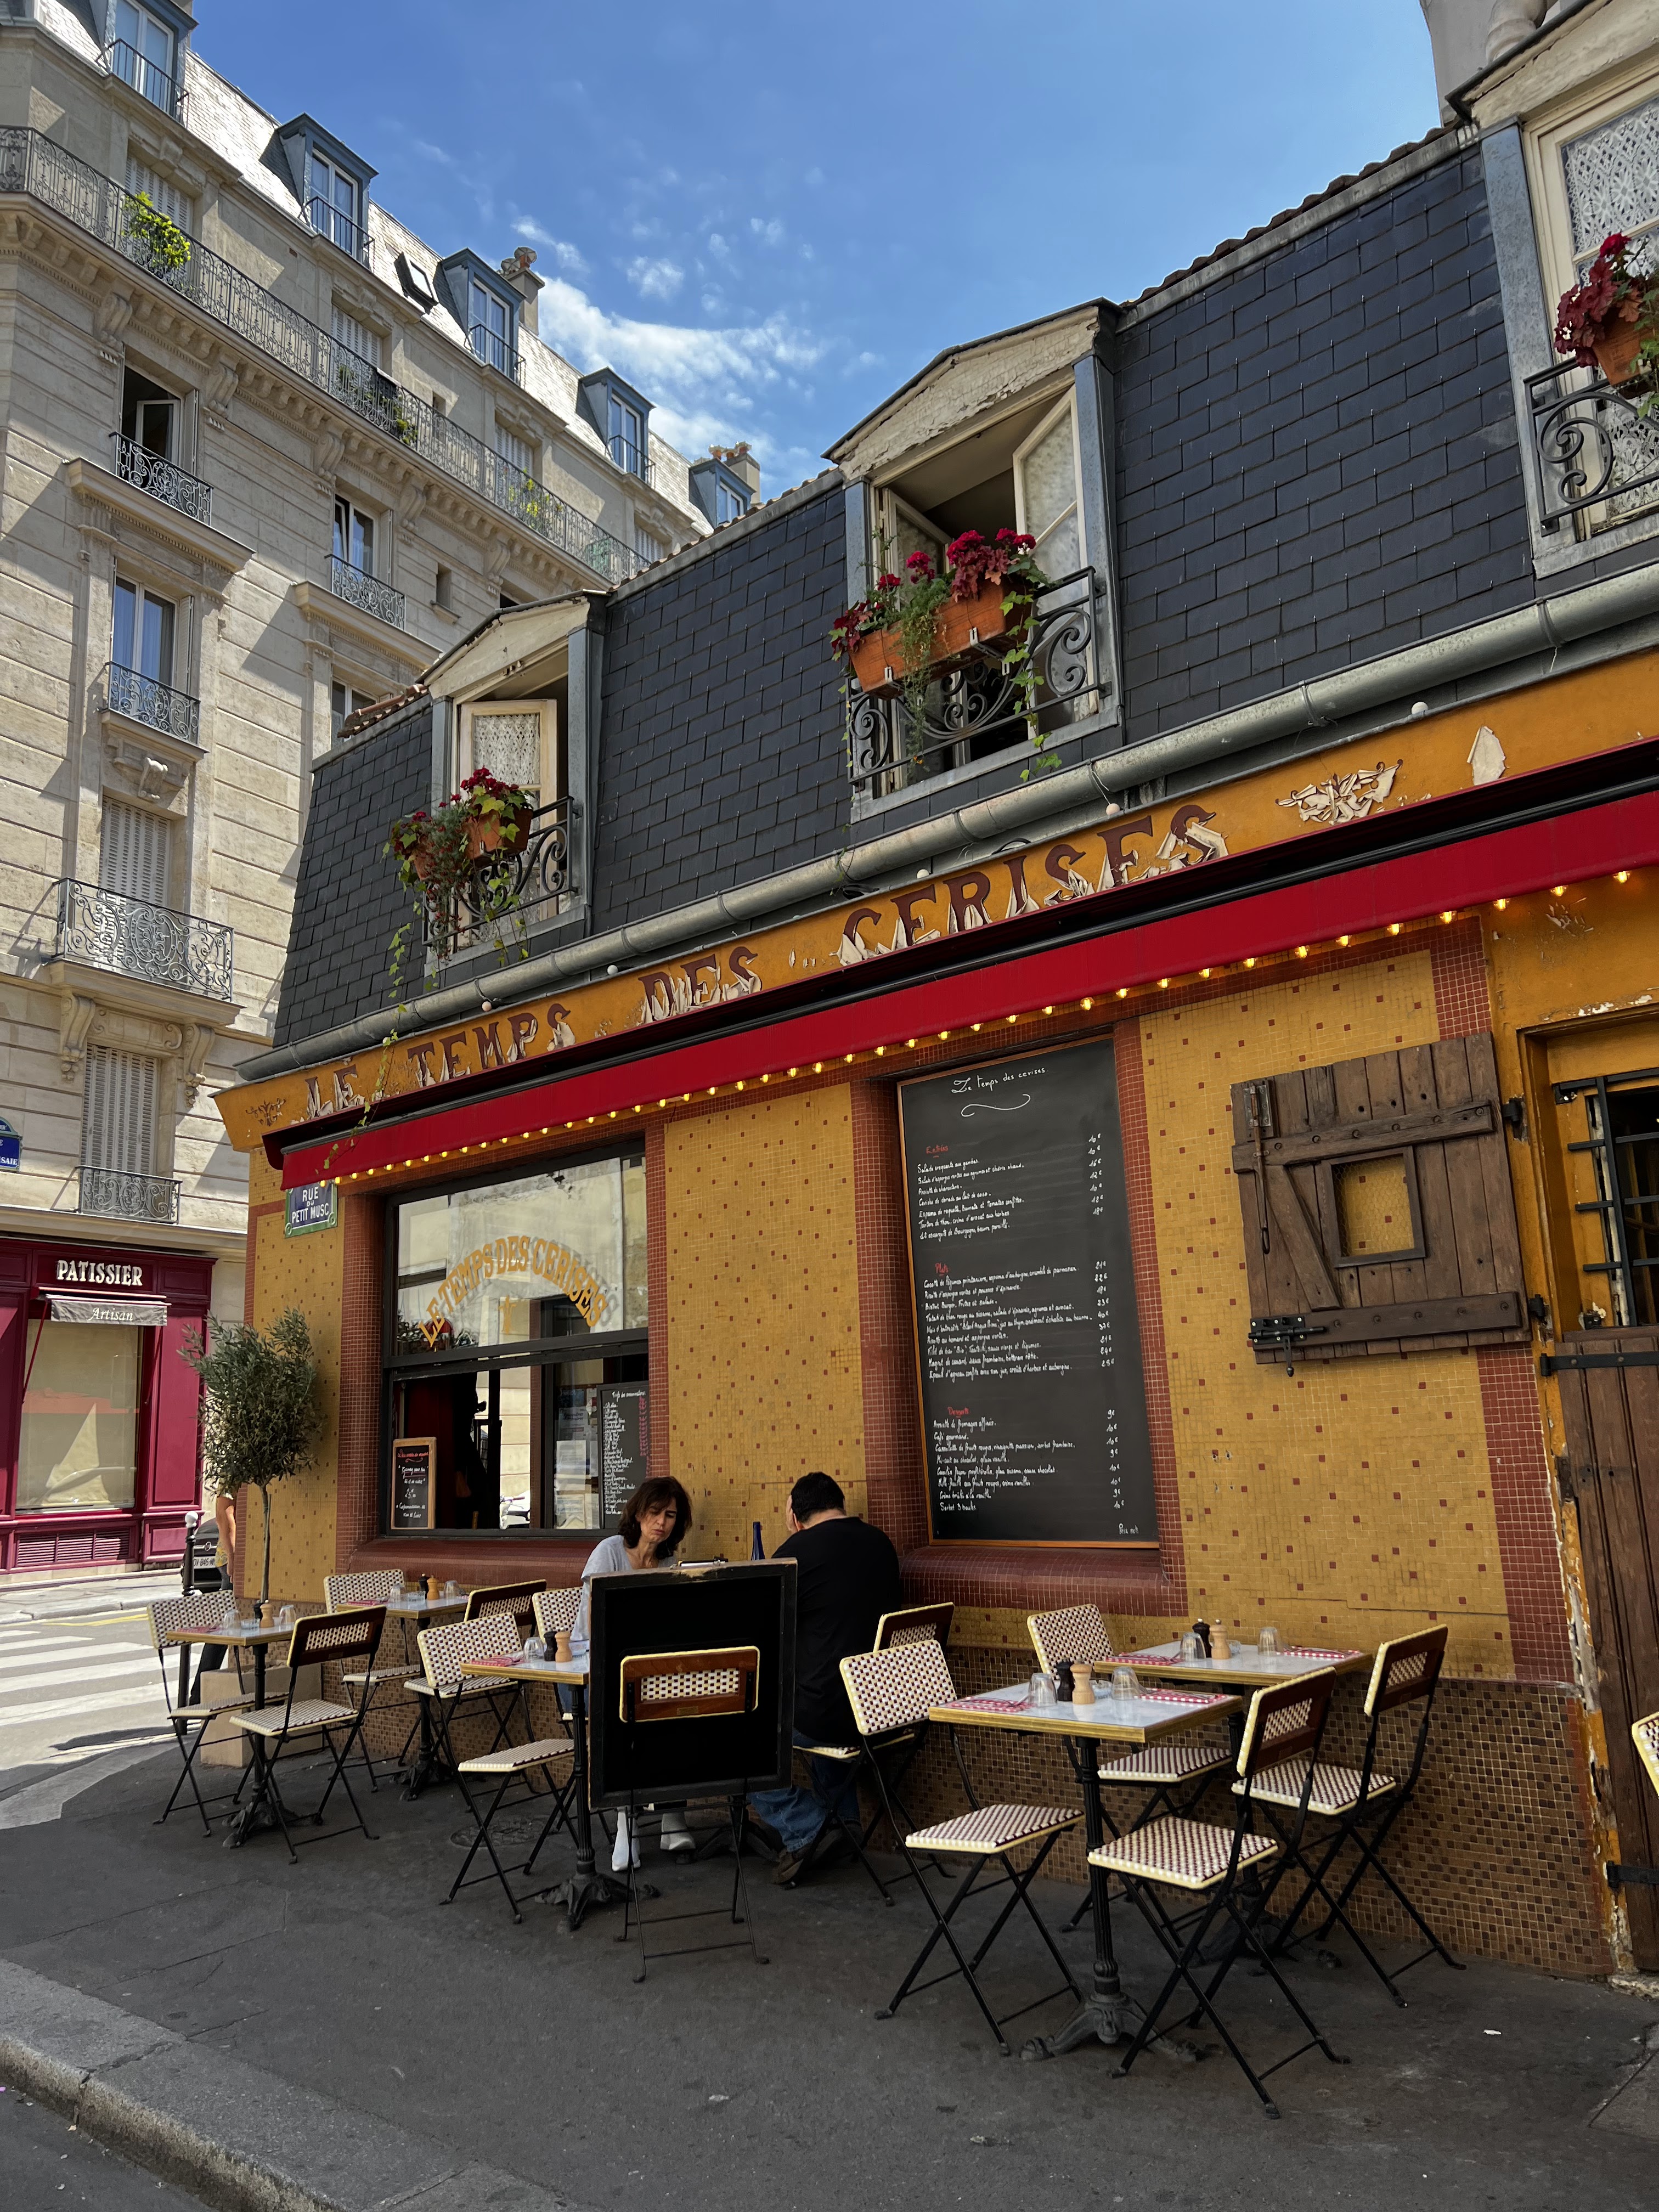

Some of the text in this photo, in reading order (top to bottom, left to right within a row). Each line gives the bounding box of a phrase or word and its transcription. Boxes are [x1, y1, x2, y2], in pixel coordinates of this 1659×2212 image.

[408, 1003, 576, 1088] TEMPS
[638, 946, 763, 1023] DES
[834, 805, 1229, 966] CERISES
[977, 1075, 998, 1091] temps
[1003, 1072, 1014, 1081] des
[302, 1187, 319, 1202] RUE
[292, 1203, 329, 1224] PETIT MUSC
[57, 1260, 143, 1286] PATISSIER
[418, 1235, 609, 1347] LE TEMPS DES CERISES
[88, 1307, 133, 1321] Artisan
